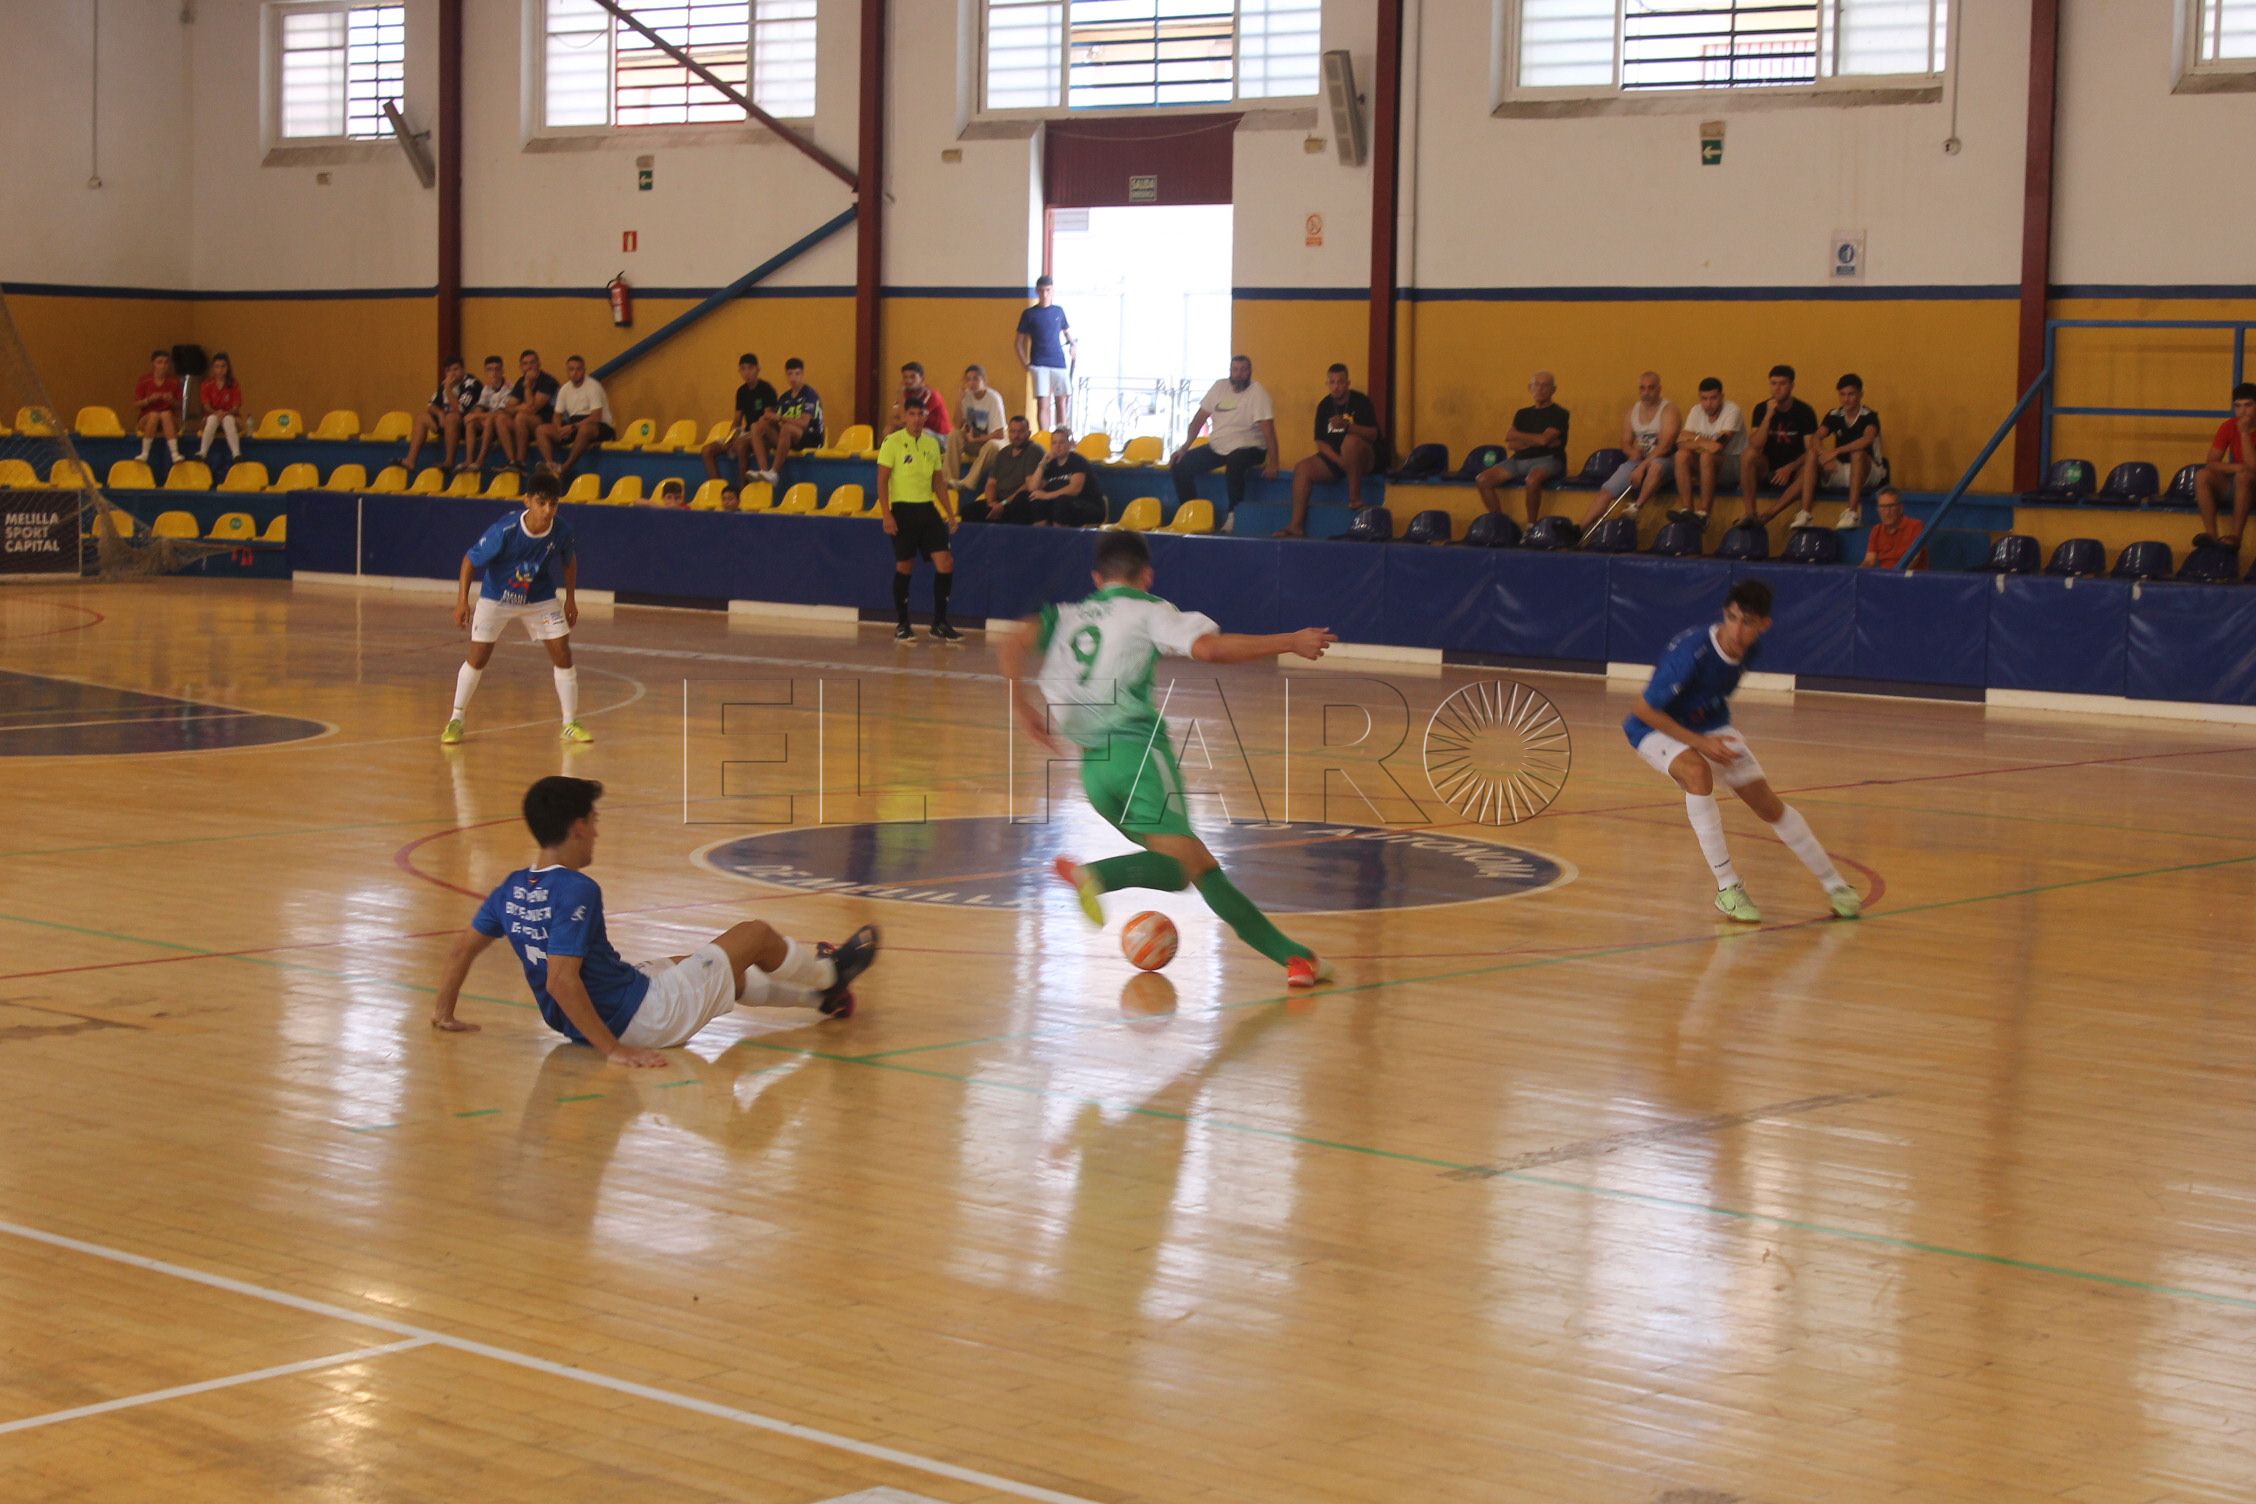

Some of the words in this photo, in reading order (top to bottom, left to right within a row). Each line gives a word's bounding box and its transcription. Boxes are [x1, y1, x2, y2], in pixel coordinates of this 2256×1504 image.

[5, 512, 60, 526] MELILLA
[4, 526, 49, 539] SPORT
[4, 539, 60, 553] CAPITAL
[1069, 624, 1102, 686] 9
